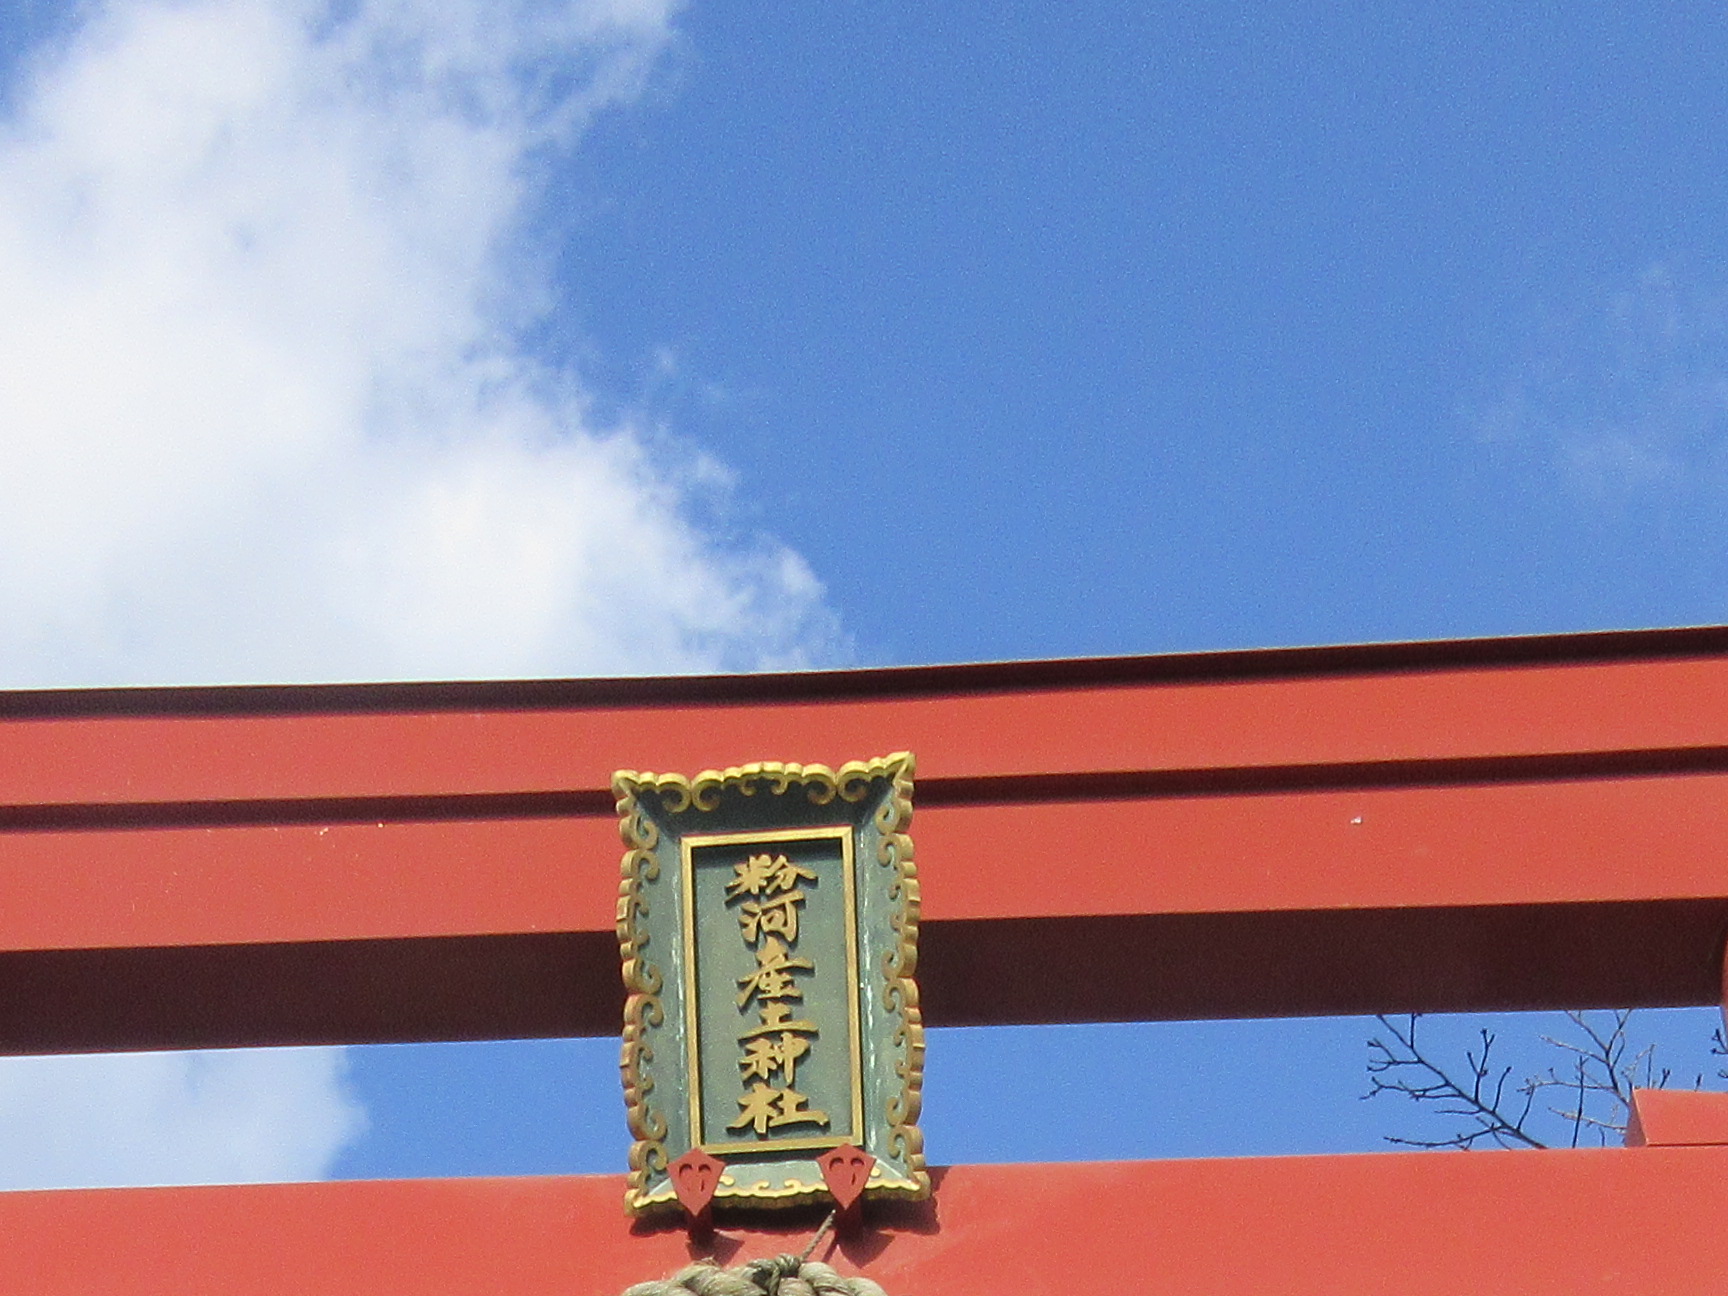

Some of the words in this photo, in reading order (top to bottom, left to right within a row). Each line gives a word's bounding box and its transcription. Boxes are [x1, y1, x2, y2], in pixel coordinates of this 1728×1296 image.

[725, 853, 831, 1136] 粉河産土神社
